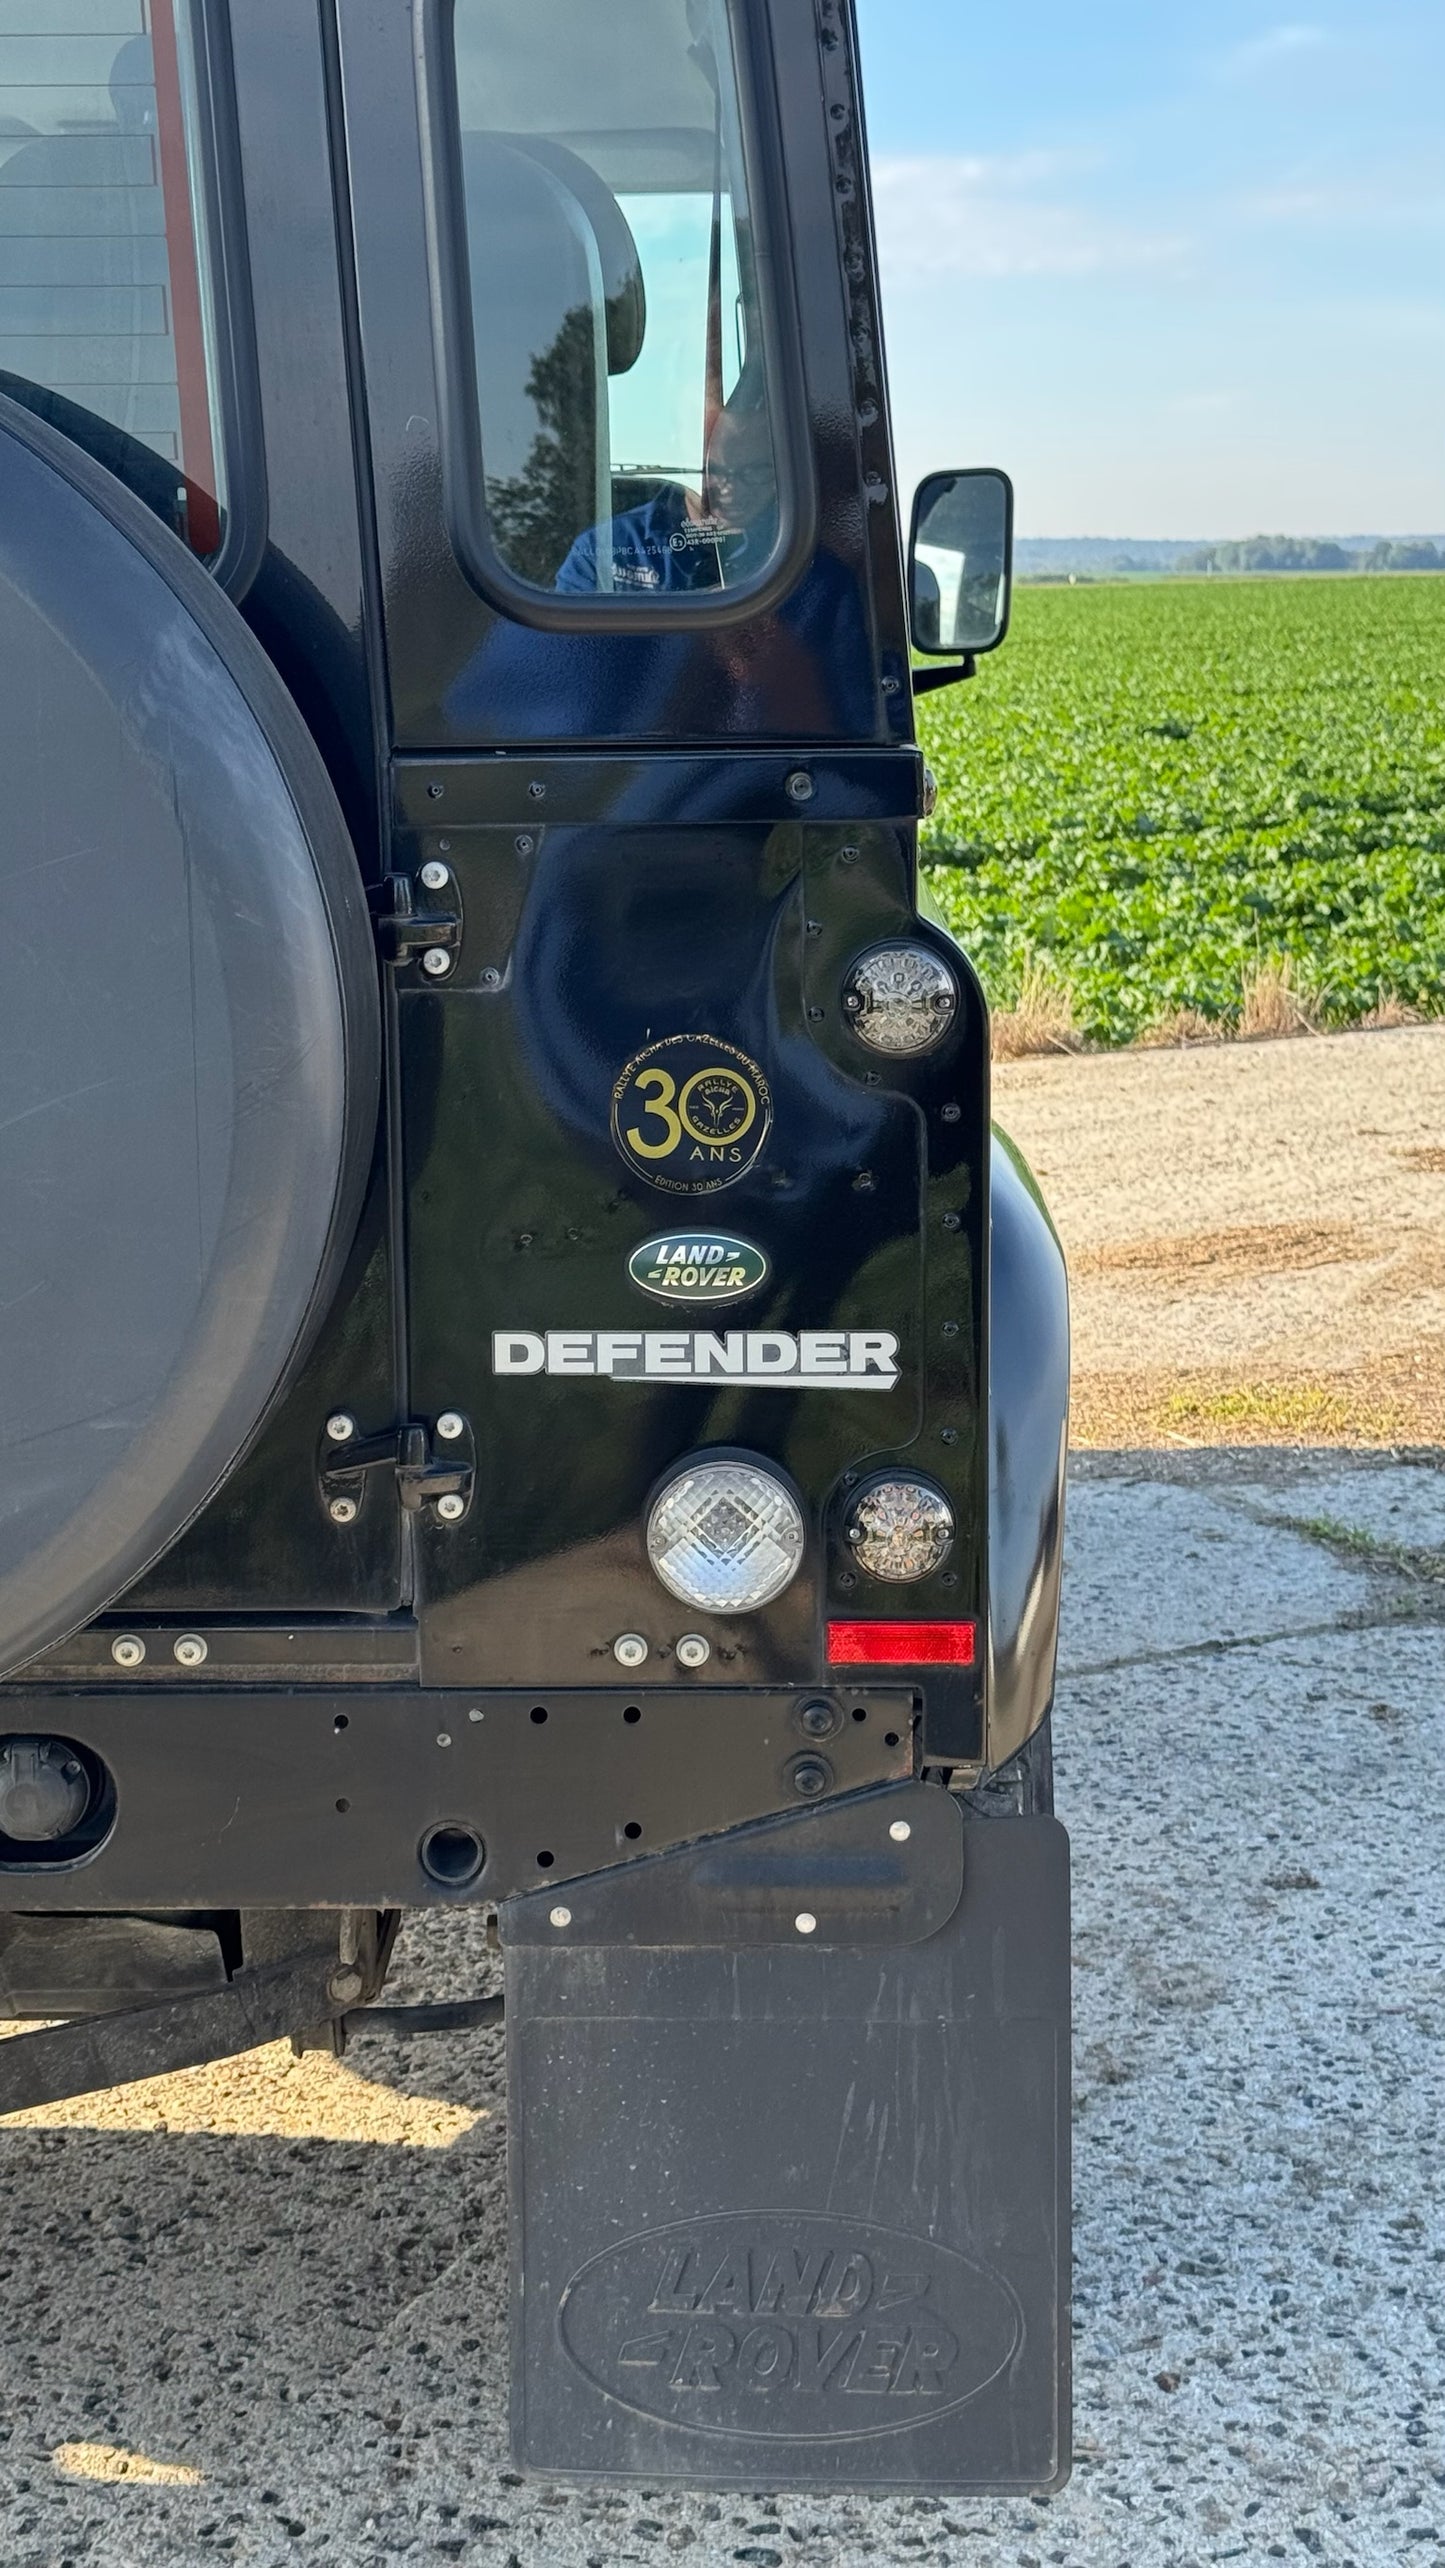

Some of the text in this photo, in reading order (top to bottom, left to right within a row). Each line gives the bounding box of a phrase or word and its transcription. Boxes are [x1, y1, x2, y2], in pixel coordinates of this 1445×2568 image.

[613, 1062, 636, 1100] RALLYE
[747, 1063, 770, 1105] MAROC
[626, 1067, 756, 1160] 30
[690, 1146, 742, 1163] ANS
[691, 1182, 704, 1192] 30
[706, 1177, 723, 1190] ANS
[656, 1244, 724, 1265] LAND
[661, 1267, 747, 1287] ROVER
[493, 1332, 898, 1374] DEFENDER
[648, 2246, 876, 2318] LAND
[669, 2324, 960, 2395] ROVER
